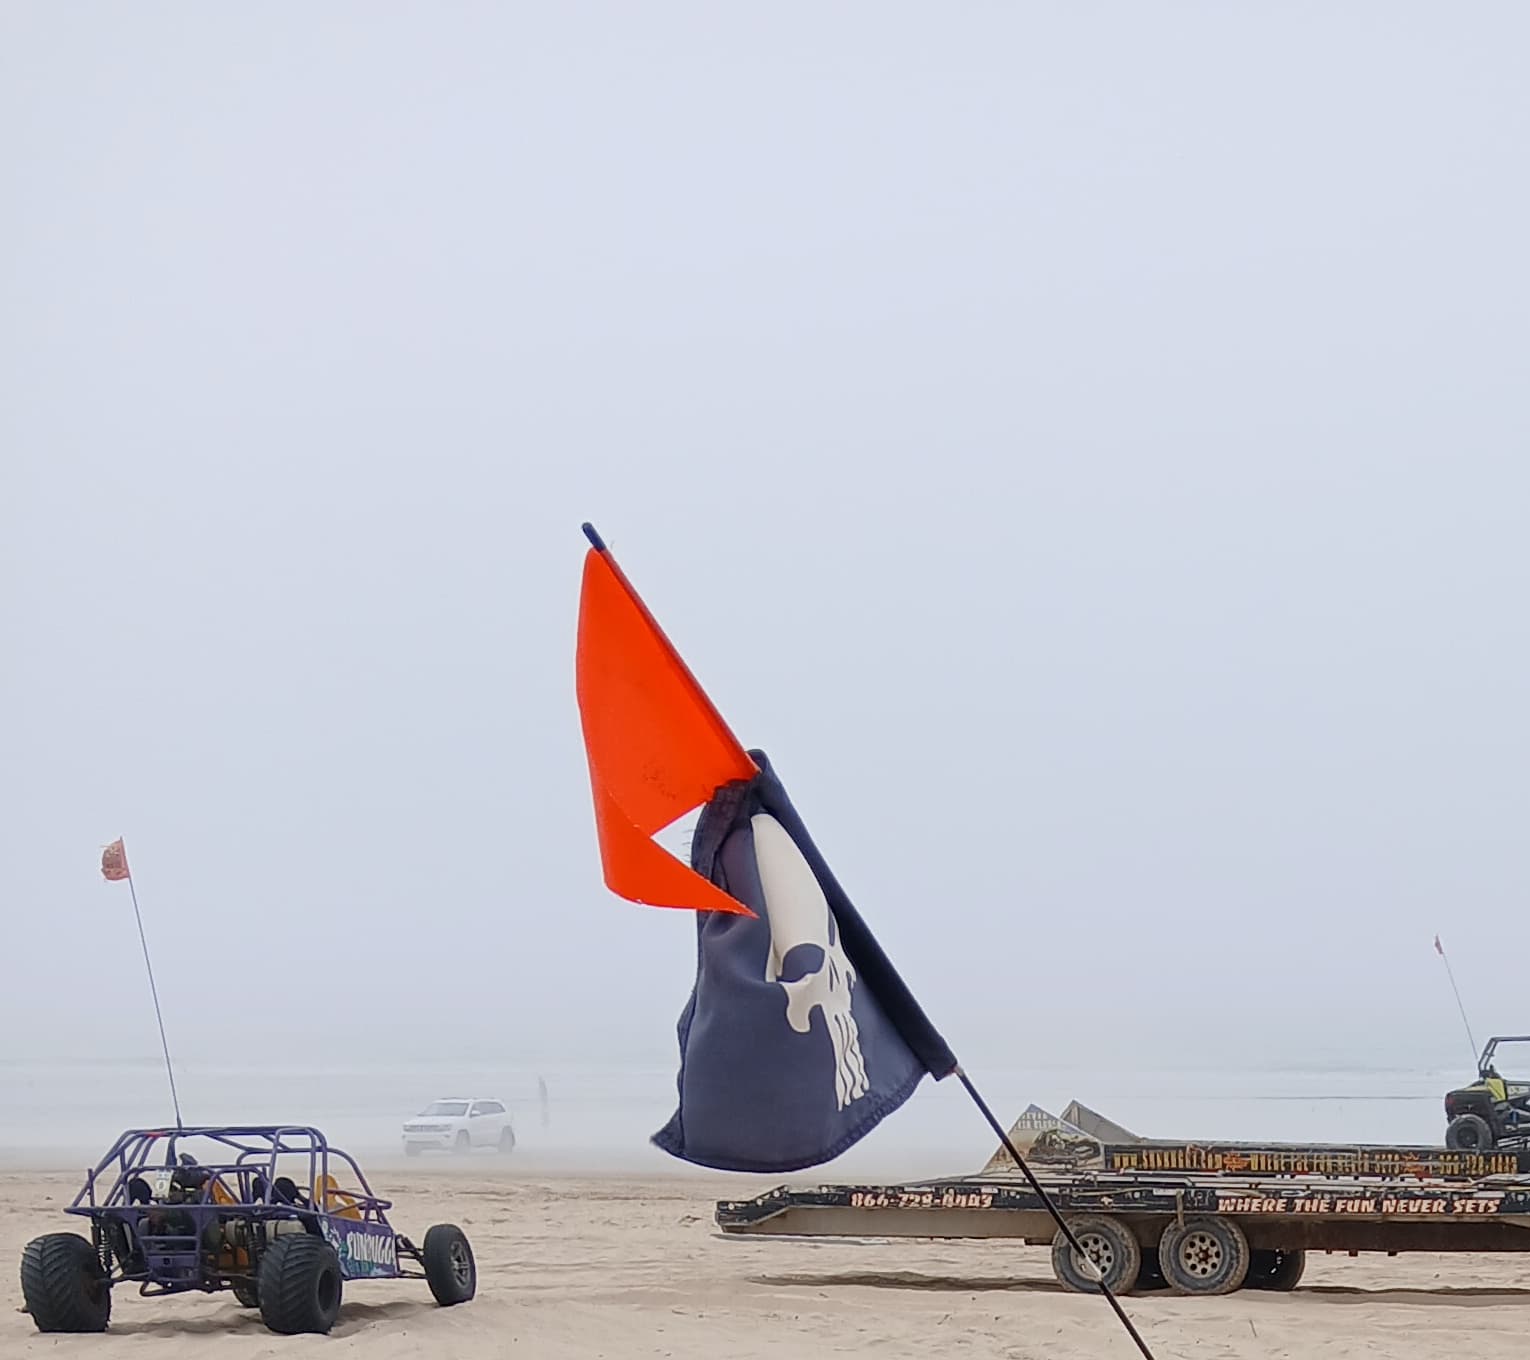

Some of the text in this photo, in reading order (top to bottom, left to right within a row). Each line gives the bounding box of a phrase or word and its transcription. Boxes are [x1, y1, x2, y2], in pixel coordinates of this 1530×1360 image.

[1218, 1198, 1501, 1214] WHERE THE FUN NEVER SETS
